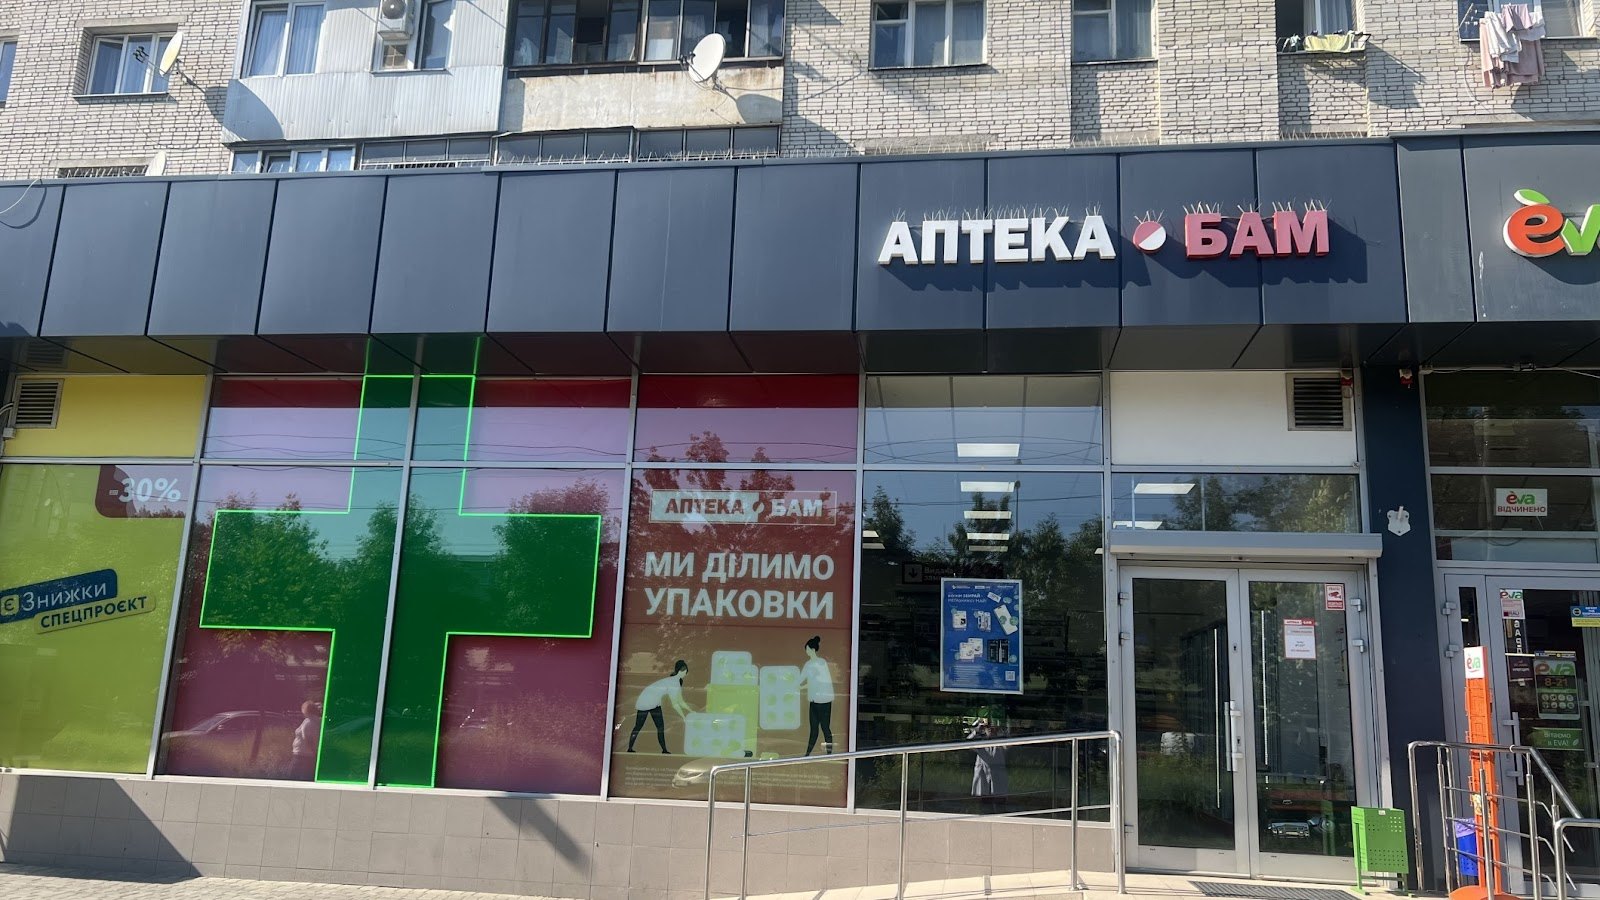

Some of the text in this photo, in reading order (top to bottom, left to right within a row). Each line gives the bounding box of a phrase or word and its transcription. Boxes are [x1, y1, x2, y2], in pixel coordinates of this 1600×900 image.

[878, 210, 1329, 264] АПТЕКА БАМ
[109, 477, 182, 503] -30%
[665, 498, 823, 517] АПТЕКА БАМ
[1497, 505, 1547, 513] ВІДЧИНЕНО
[644, 551, 835, 583] МИ ДІЛИМО
[40, 595, 148, 629] СПЕЦПРОЄКТ
[644, 587, 834, 620] УПАКОВКИ
